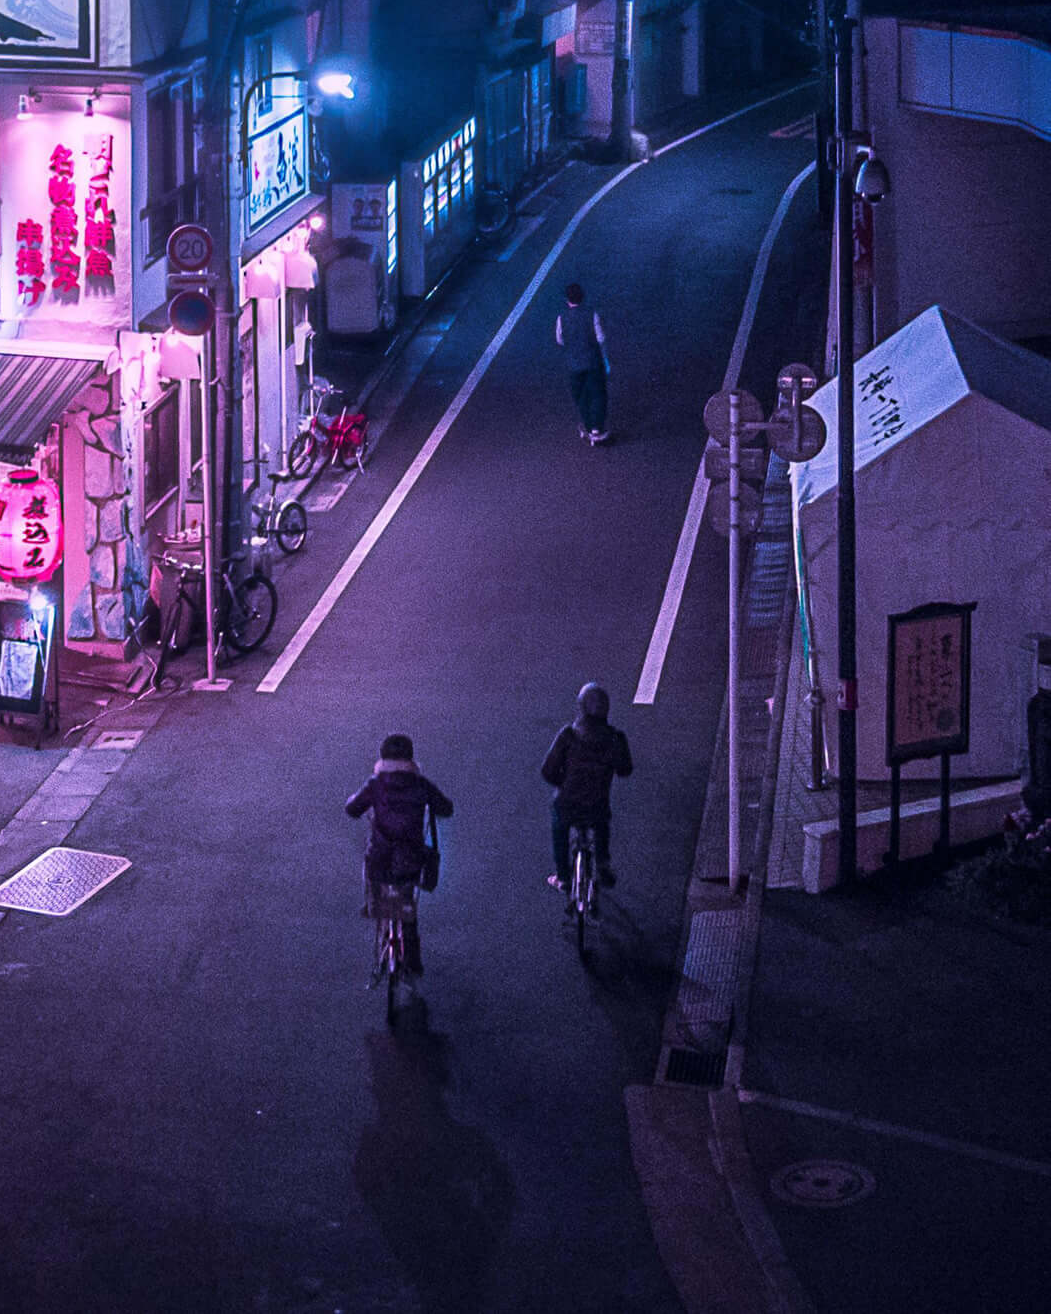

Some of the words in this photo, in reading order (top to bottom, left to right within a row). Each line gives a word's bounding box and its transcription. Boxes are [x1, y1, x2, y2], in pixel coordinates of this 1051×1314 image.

[48, 143, 81, 292] 名物煮込み
[179, 239, 204, 260] 20
